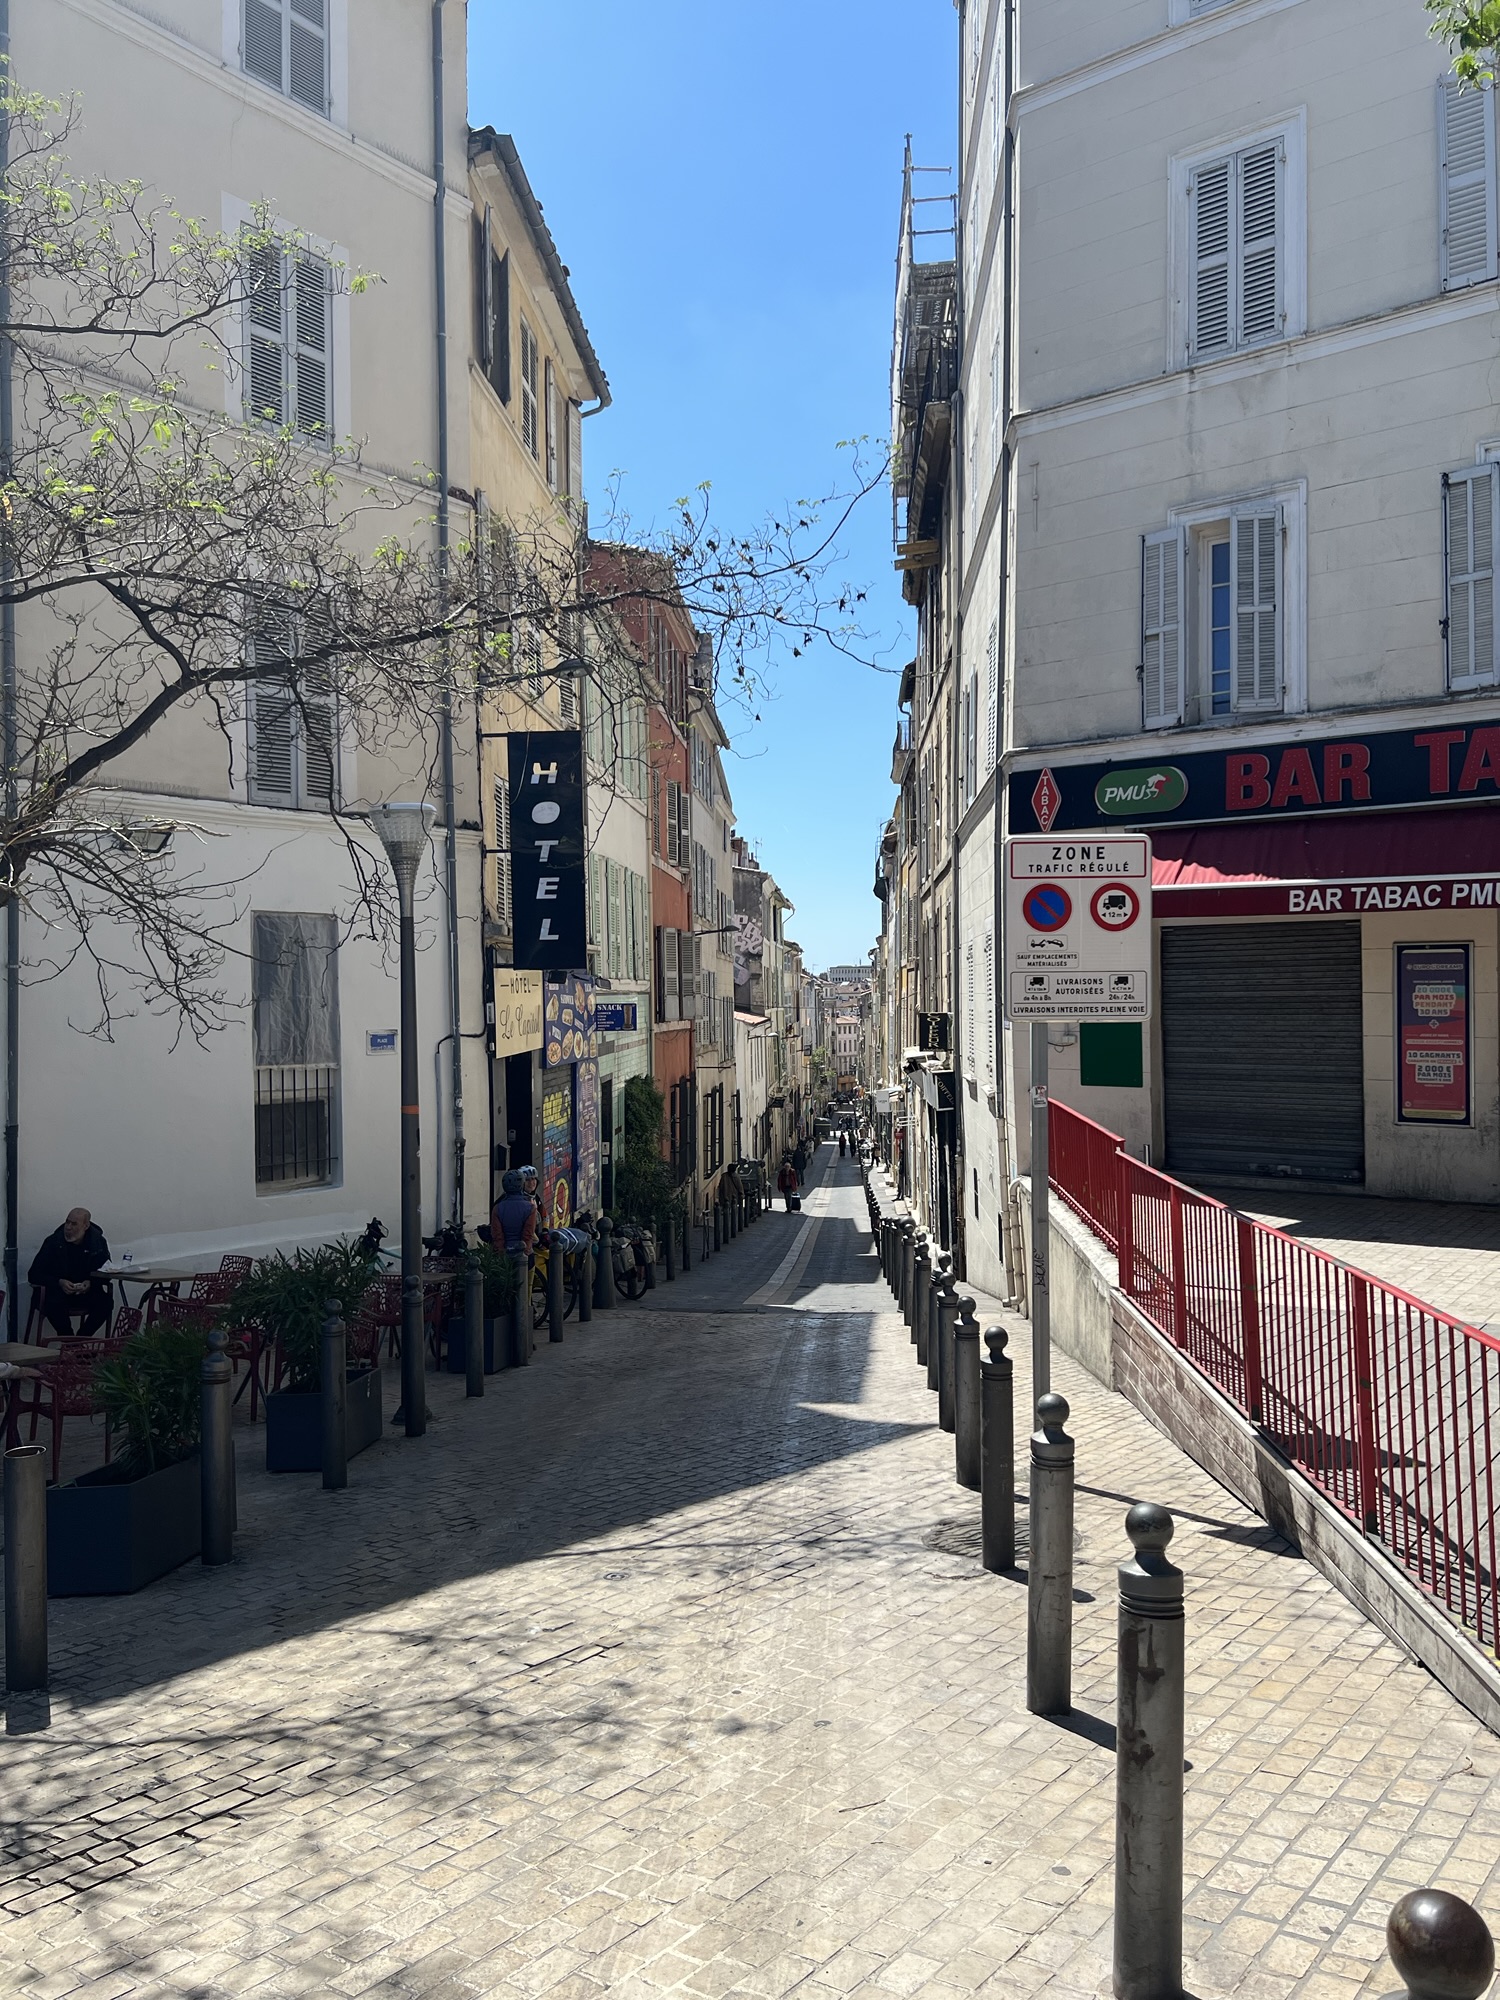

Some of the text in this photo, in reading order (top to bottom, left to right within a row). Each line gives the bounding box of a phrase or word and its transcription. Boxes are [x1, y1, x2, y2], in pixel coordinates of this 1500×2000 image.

[1225, 743, 1372, 811] BAR
[1041, 775, 1050, 825] TABAC
[1104, 784, 1146, 803] PMU
[530, 762, 561, 941] HOTEL
[1052, 846, 1105, 860] ZONE
[1028, 861, 1129, 873] TRAFIC RÉGULÉ
[1289, 888, 1342, 912] BAR
[1350, 884, 1442, 909] TABAC
[510, 973, 531, 994] HÔTEL
[1055, 986, 1105, 995] AUTORISÉES
[1013, 1006, 1056, 1014] LIVRAISONS
[1057, 1006, 1099, 1014] INTERDITES
